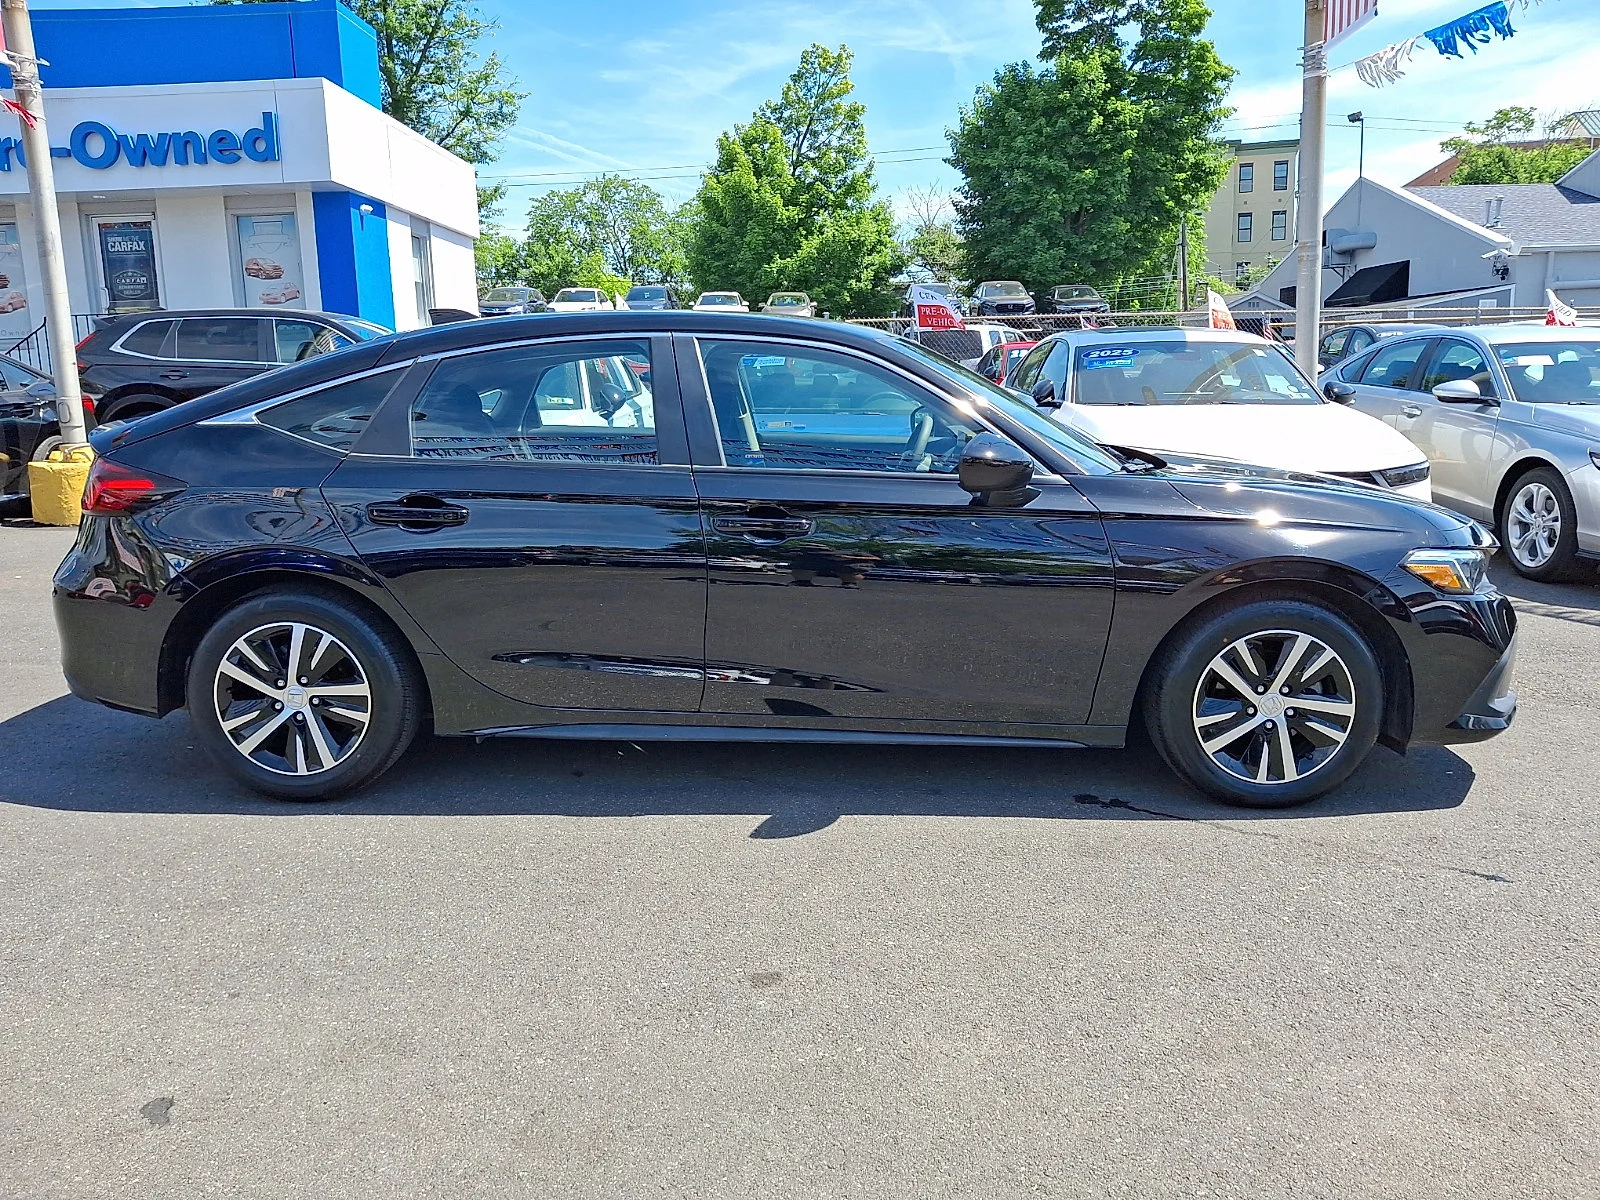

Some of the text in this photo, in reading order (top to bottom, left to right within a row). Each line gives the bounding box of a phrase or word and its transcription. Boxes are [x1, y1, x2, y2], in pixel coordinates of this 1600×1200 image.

[0, 111, 279, 172] r-Owned
[108, 241, 145, 252] CARFAX
[1088, 349, 1134, 358] 2025
